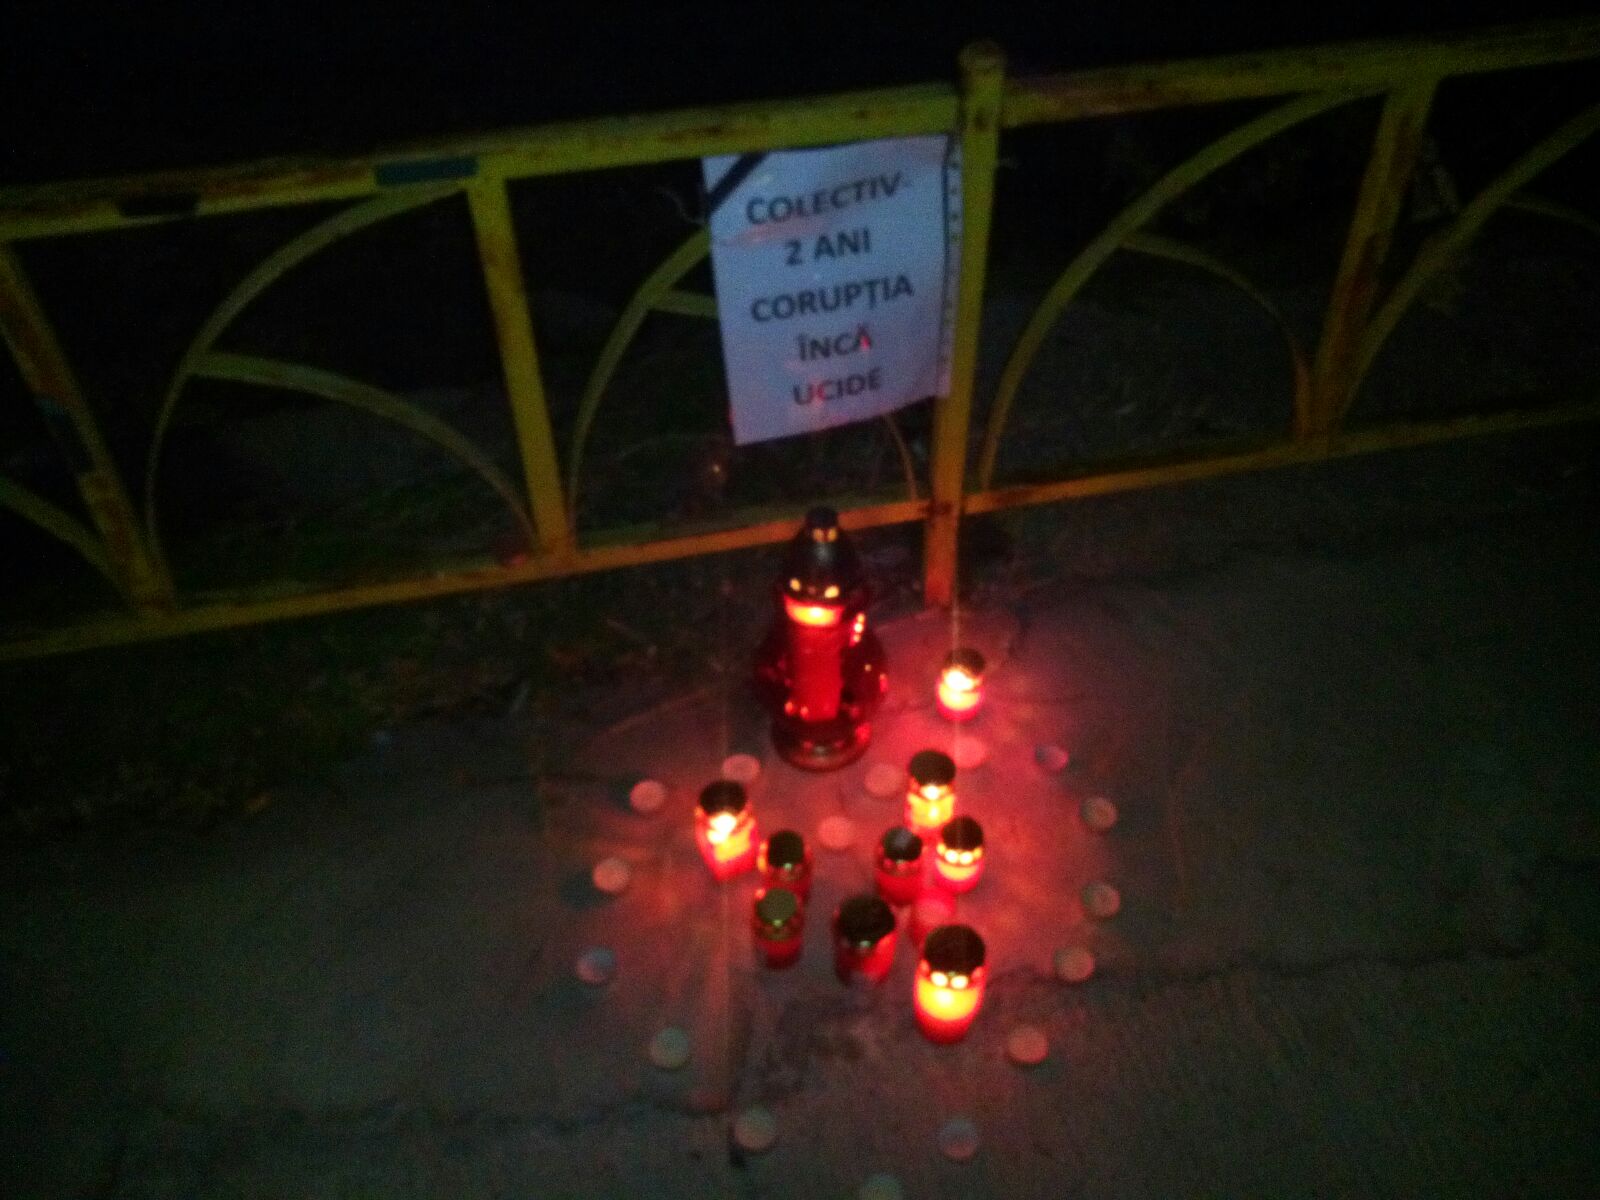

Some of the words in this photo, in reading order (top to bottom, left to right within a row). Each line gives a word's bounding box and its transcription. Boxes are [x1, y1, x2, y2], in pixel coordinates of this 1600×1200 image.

[785, 240, 803, 266] 2
[814, 228, 871, 260] ANI
[793, 367, 883, 406] UCIDE
